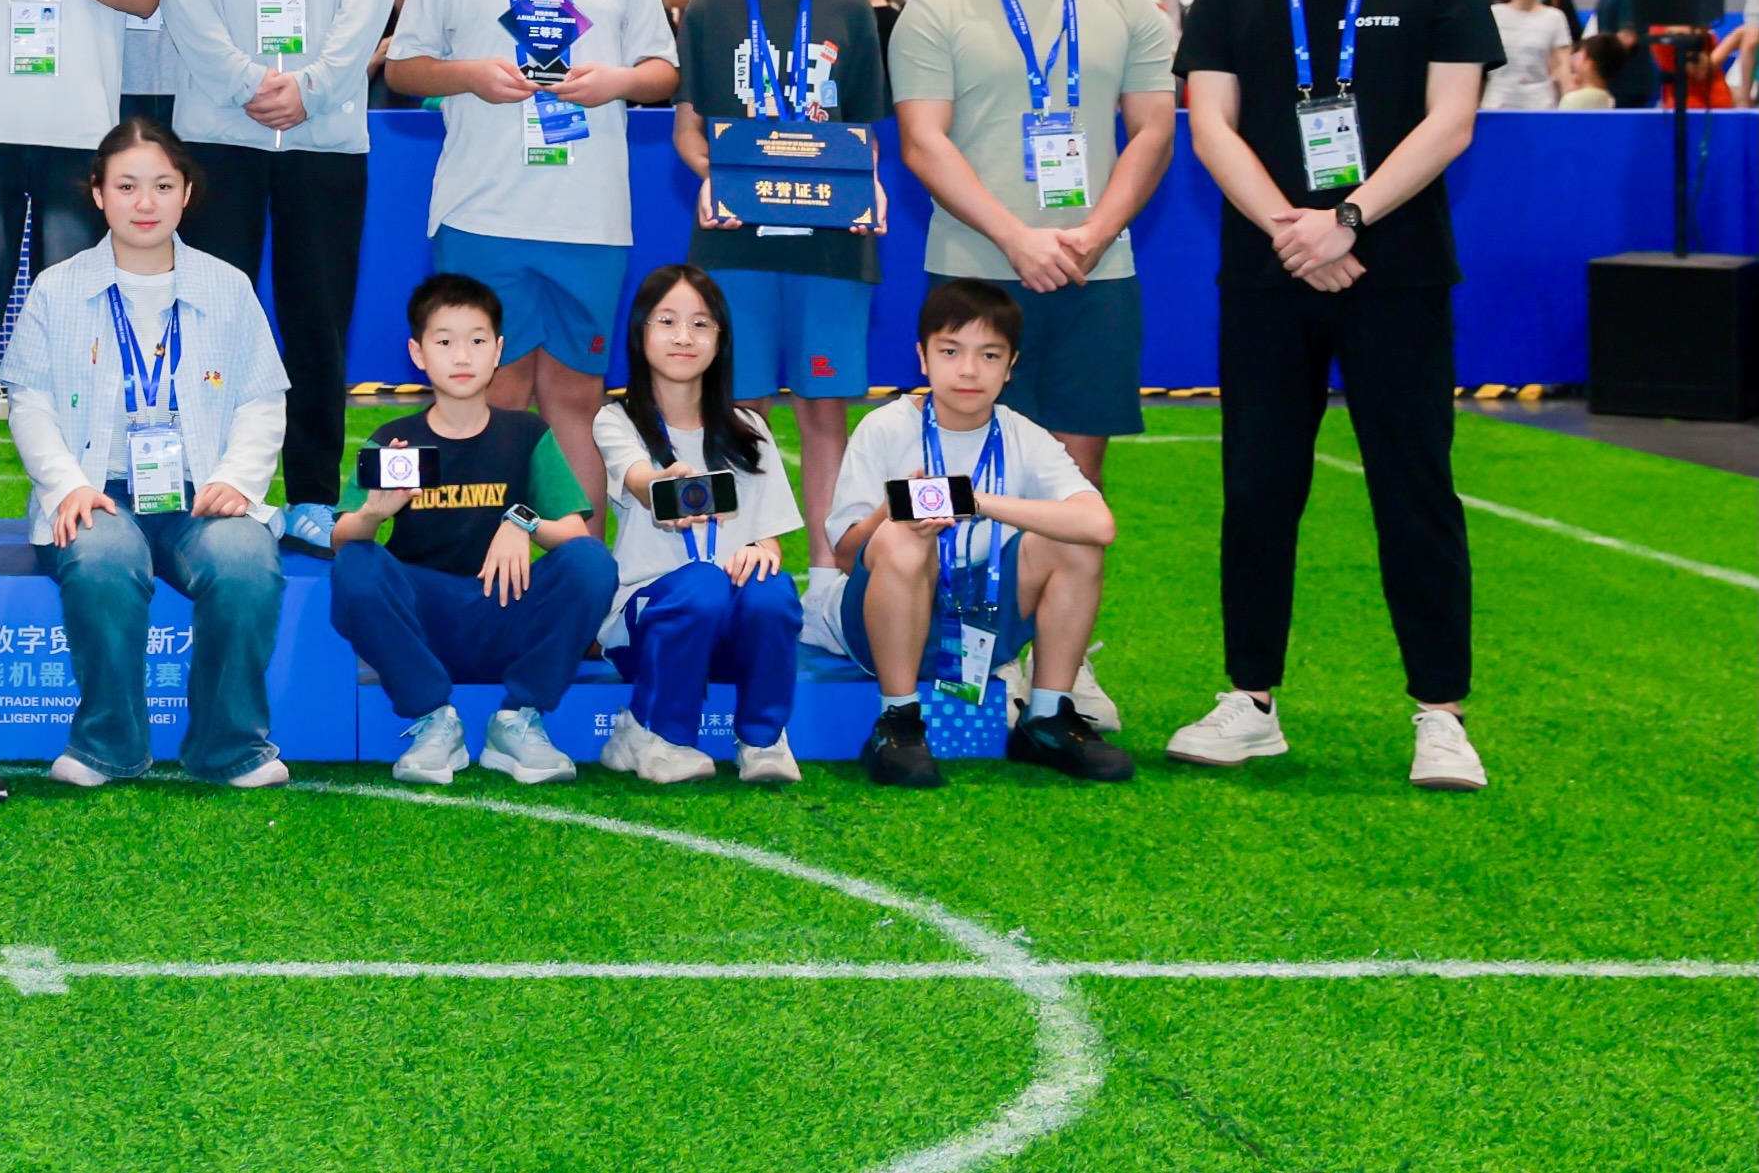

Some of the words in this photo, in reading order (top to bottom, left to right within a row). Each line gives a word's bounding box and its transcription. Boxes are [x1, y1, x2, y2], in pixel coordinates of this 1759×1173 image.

[528, 26, 563, 39] 三等奖
[755, 180, 832, 200] 荣誉证书
[42, 696, 82, 707] INNOV
